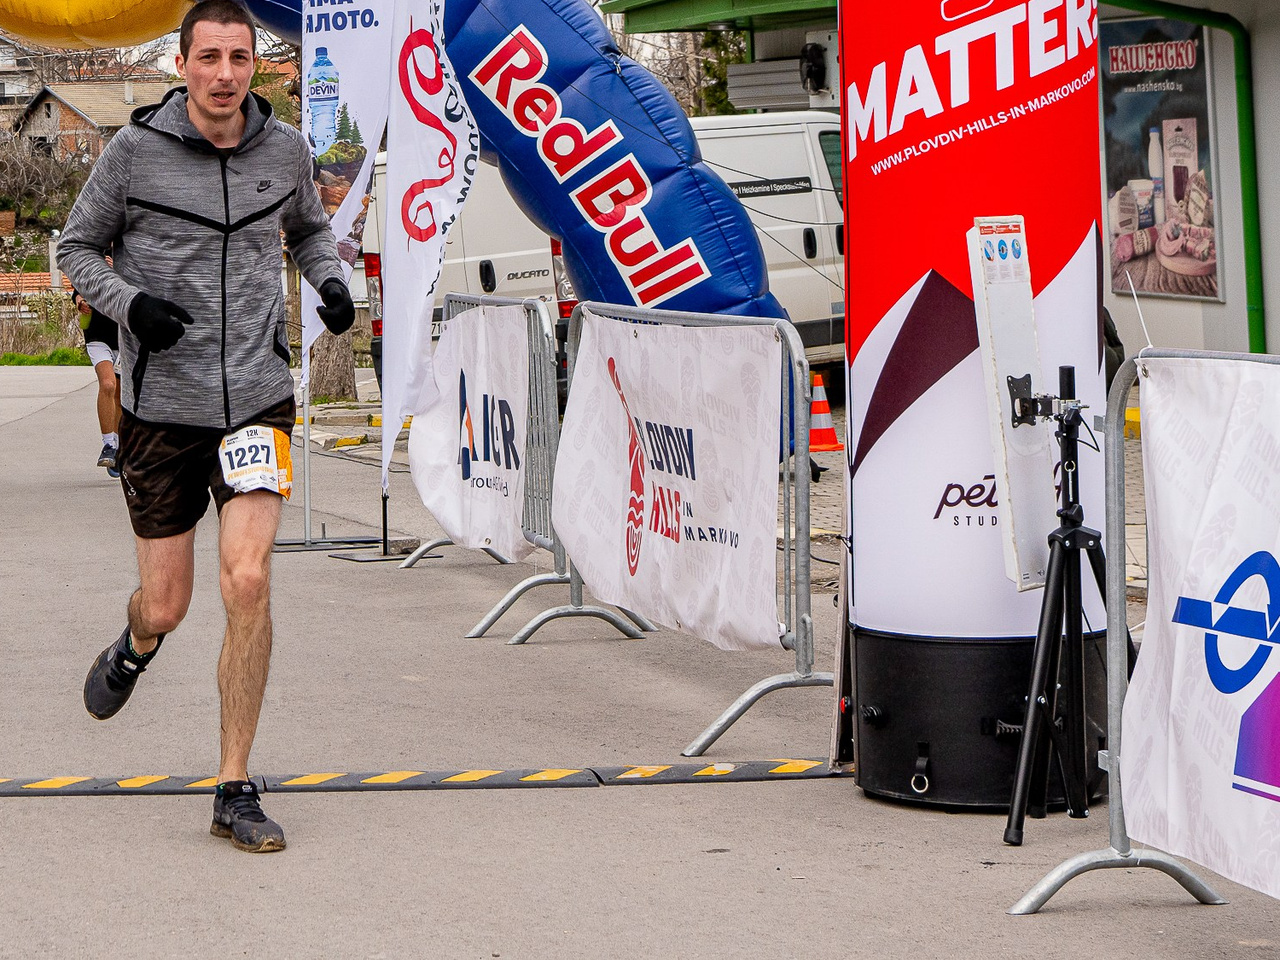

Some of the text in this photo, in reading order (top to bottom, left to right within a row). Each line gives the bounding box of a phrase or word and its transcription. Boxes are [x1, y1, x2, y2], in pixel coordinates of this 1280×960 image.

[1108, 40, 1196, 74] НАШЕНСКО
[310, 84, 336, 96] DEVIN
[871, 66, 1096, 176] WWW.PLOVDIV-HILLS-IN-MARKOVO.COM
[470, 26, 709, 307] Red Bull
[507, 268, 549, 281] DUCATO
[225, 444, 270, 470] 1227
[683, 501, 694, 518] IN
[953, 515, 998, 526] STUD
